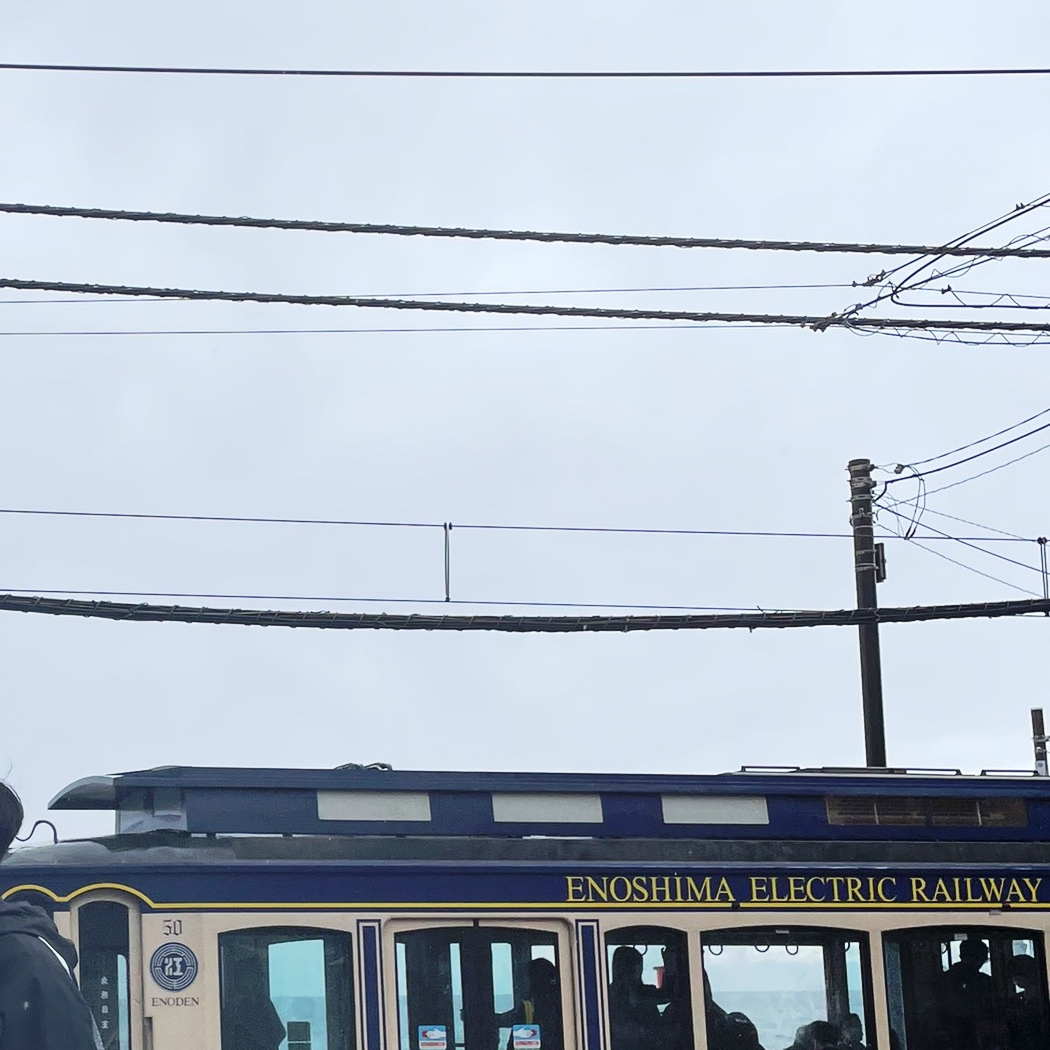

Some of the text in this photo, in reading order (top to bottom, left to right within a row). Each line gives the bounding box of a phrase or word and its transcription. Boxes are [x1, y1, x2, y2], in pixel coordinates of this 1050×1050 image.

[566, 876, 1042, 903] ENOSHIMA ELECTRIC RAILWAY
[163, 919, 183, 936] 50
[151, 997, 199, 1007] ENODEN
